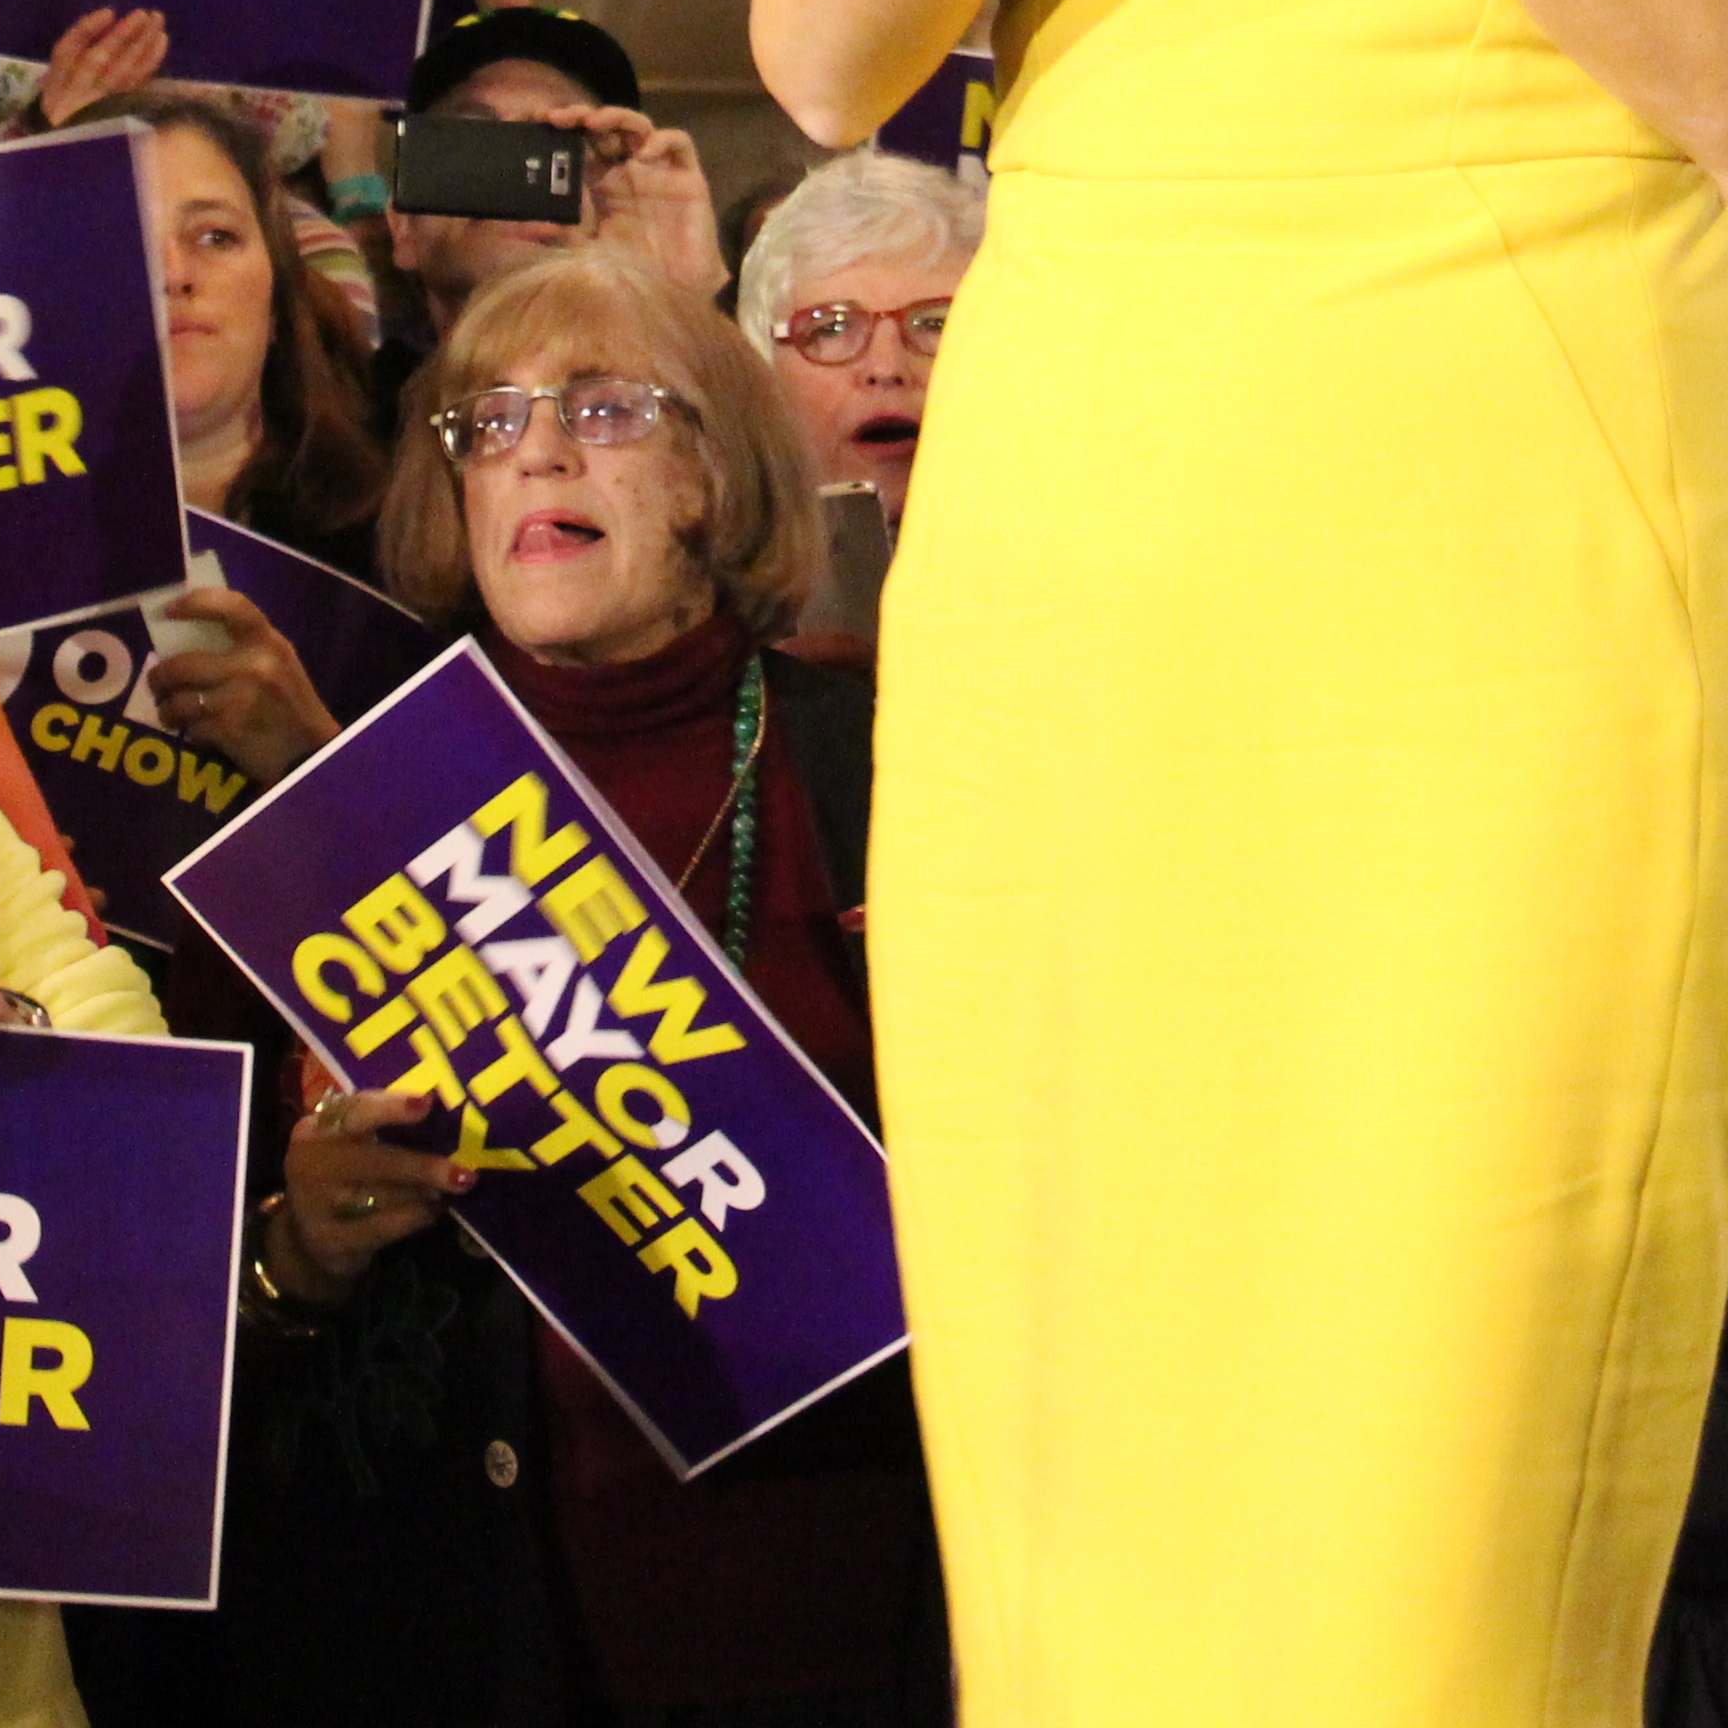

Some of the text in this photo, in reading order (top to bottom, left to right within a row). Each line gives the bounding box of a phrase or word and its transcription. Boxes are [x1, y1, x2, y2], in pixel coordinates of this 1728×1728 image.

[30, 702, 249, 815] CHOW
[291, 932, 538, 1172] CITY
[405, 821, 767, 1232] MAYOR
[468, 771, 748, 1065] NEW
[341, 872, 739, 1321] BETTER
